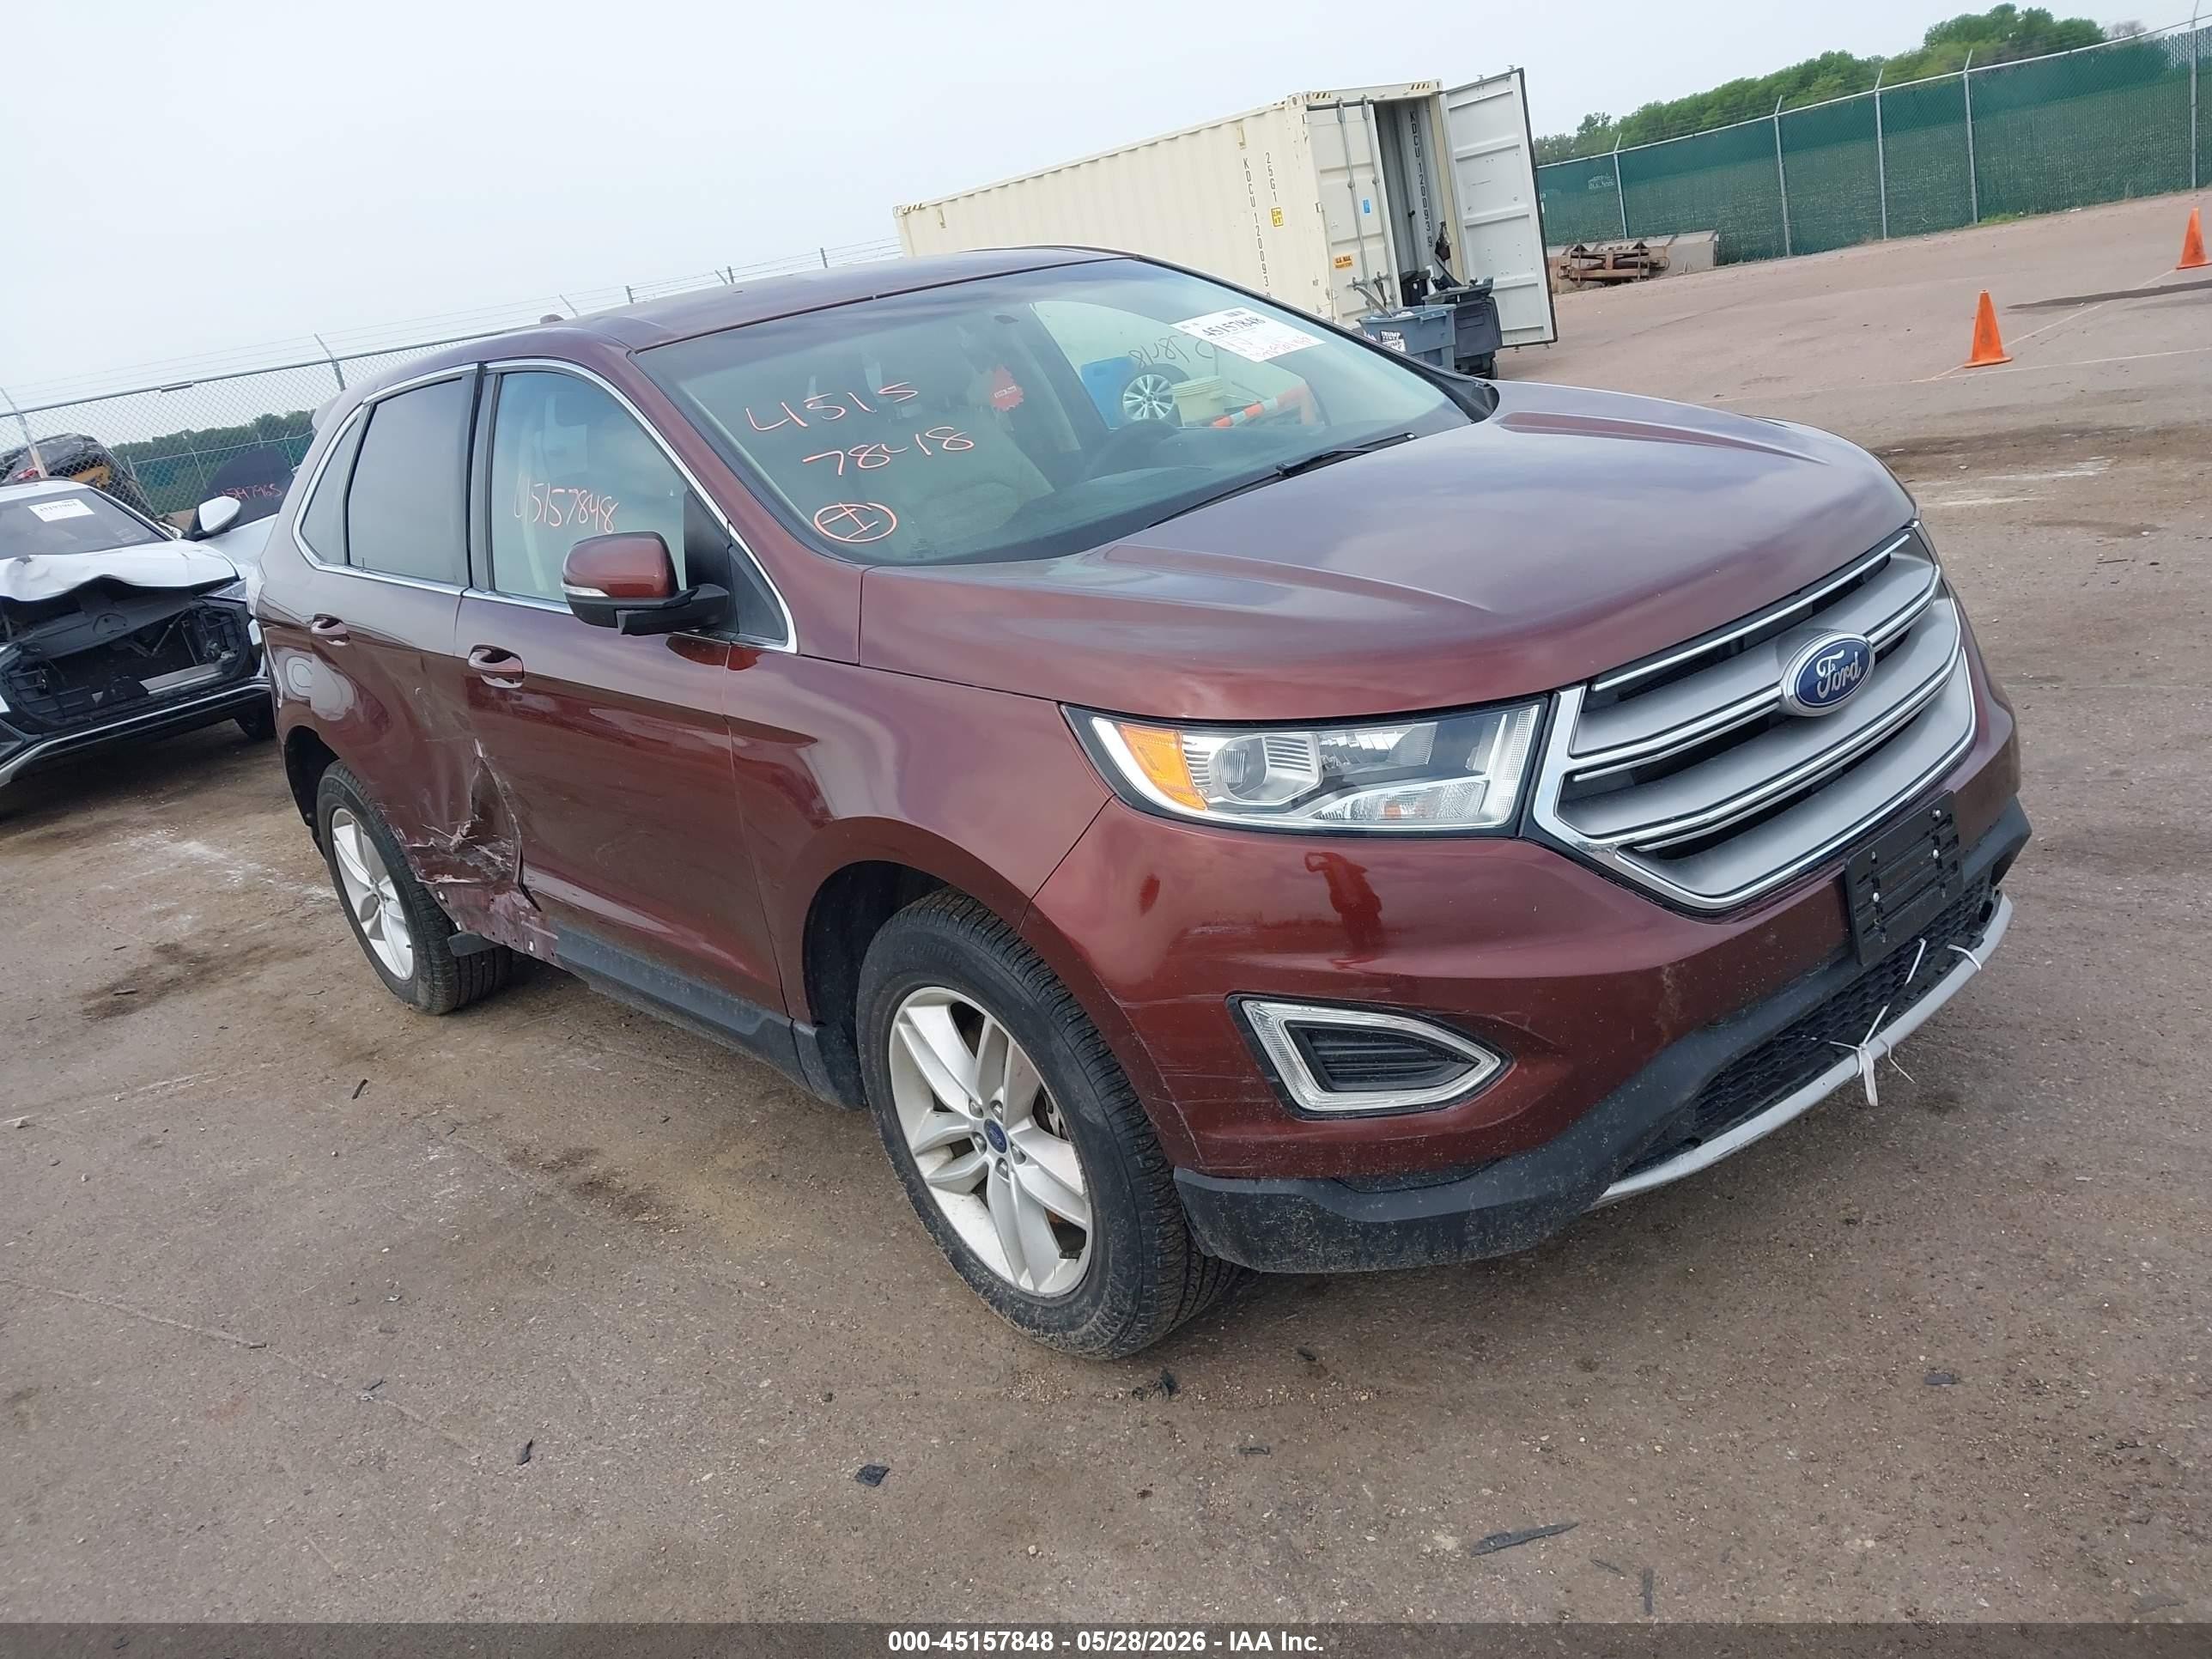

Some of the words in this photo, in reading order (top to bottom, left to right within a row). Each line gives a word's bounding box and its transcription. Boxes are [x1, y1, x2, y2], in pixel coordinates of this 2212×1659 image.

[1410, 111, 1420, 158] KDCU
[1243, 157, 1256, 208] KDCU
[1254, 212, 1269, 288] 120093
[744, 381, 919, 431] 4515
[514, 471, 619, 533] 45157848
[1816, 649, 1862, 699] Ford
